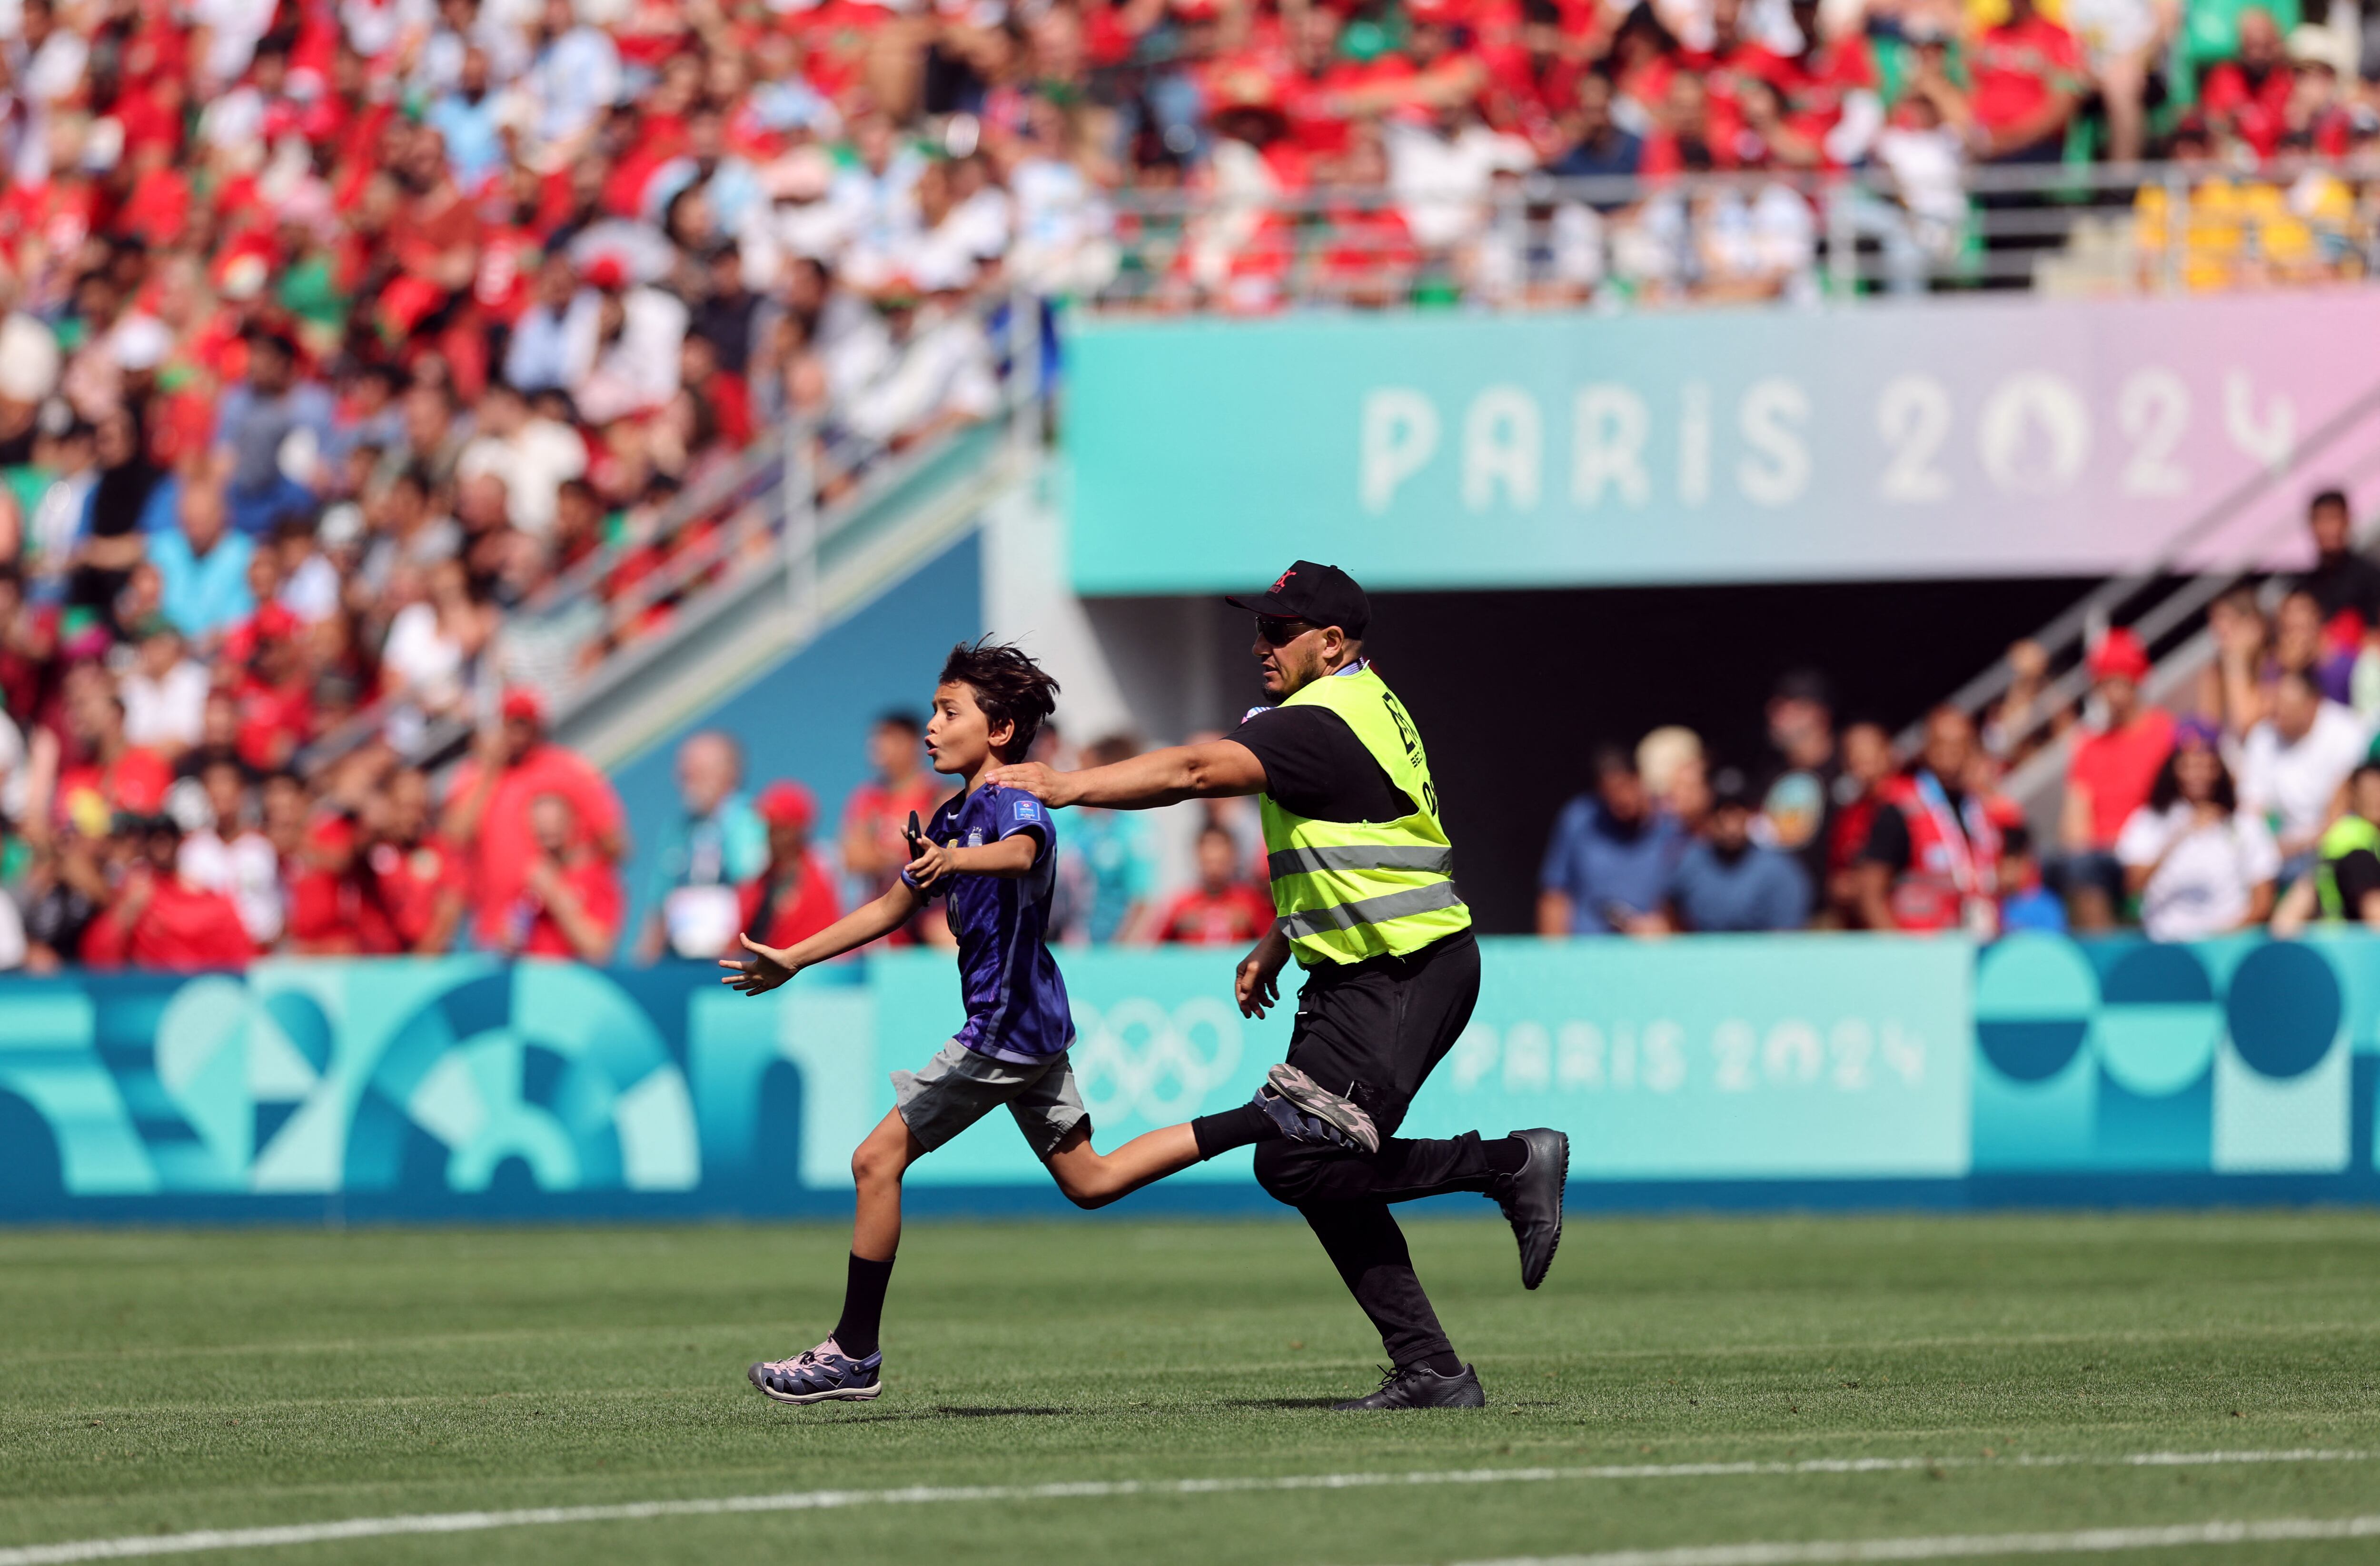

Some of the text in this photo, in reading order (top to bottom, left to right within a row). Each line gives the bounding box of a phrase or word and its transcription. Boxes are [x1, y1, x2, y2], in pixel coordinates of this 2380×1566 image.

[1361, 367, 2297, 513] PARIS 2024
[1452, 1017, 1926, 1094] PARIS 2024
